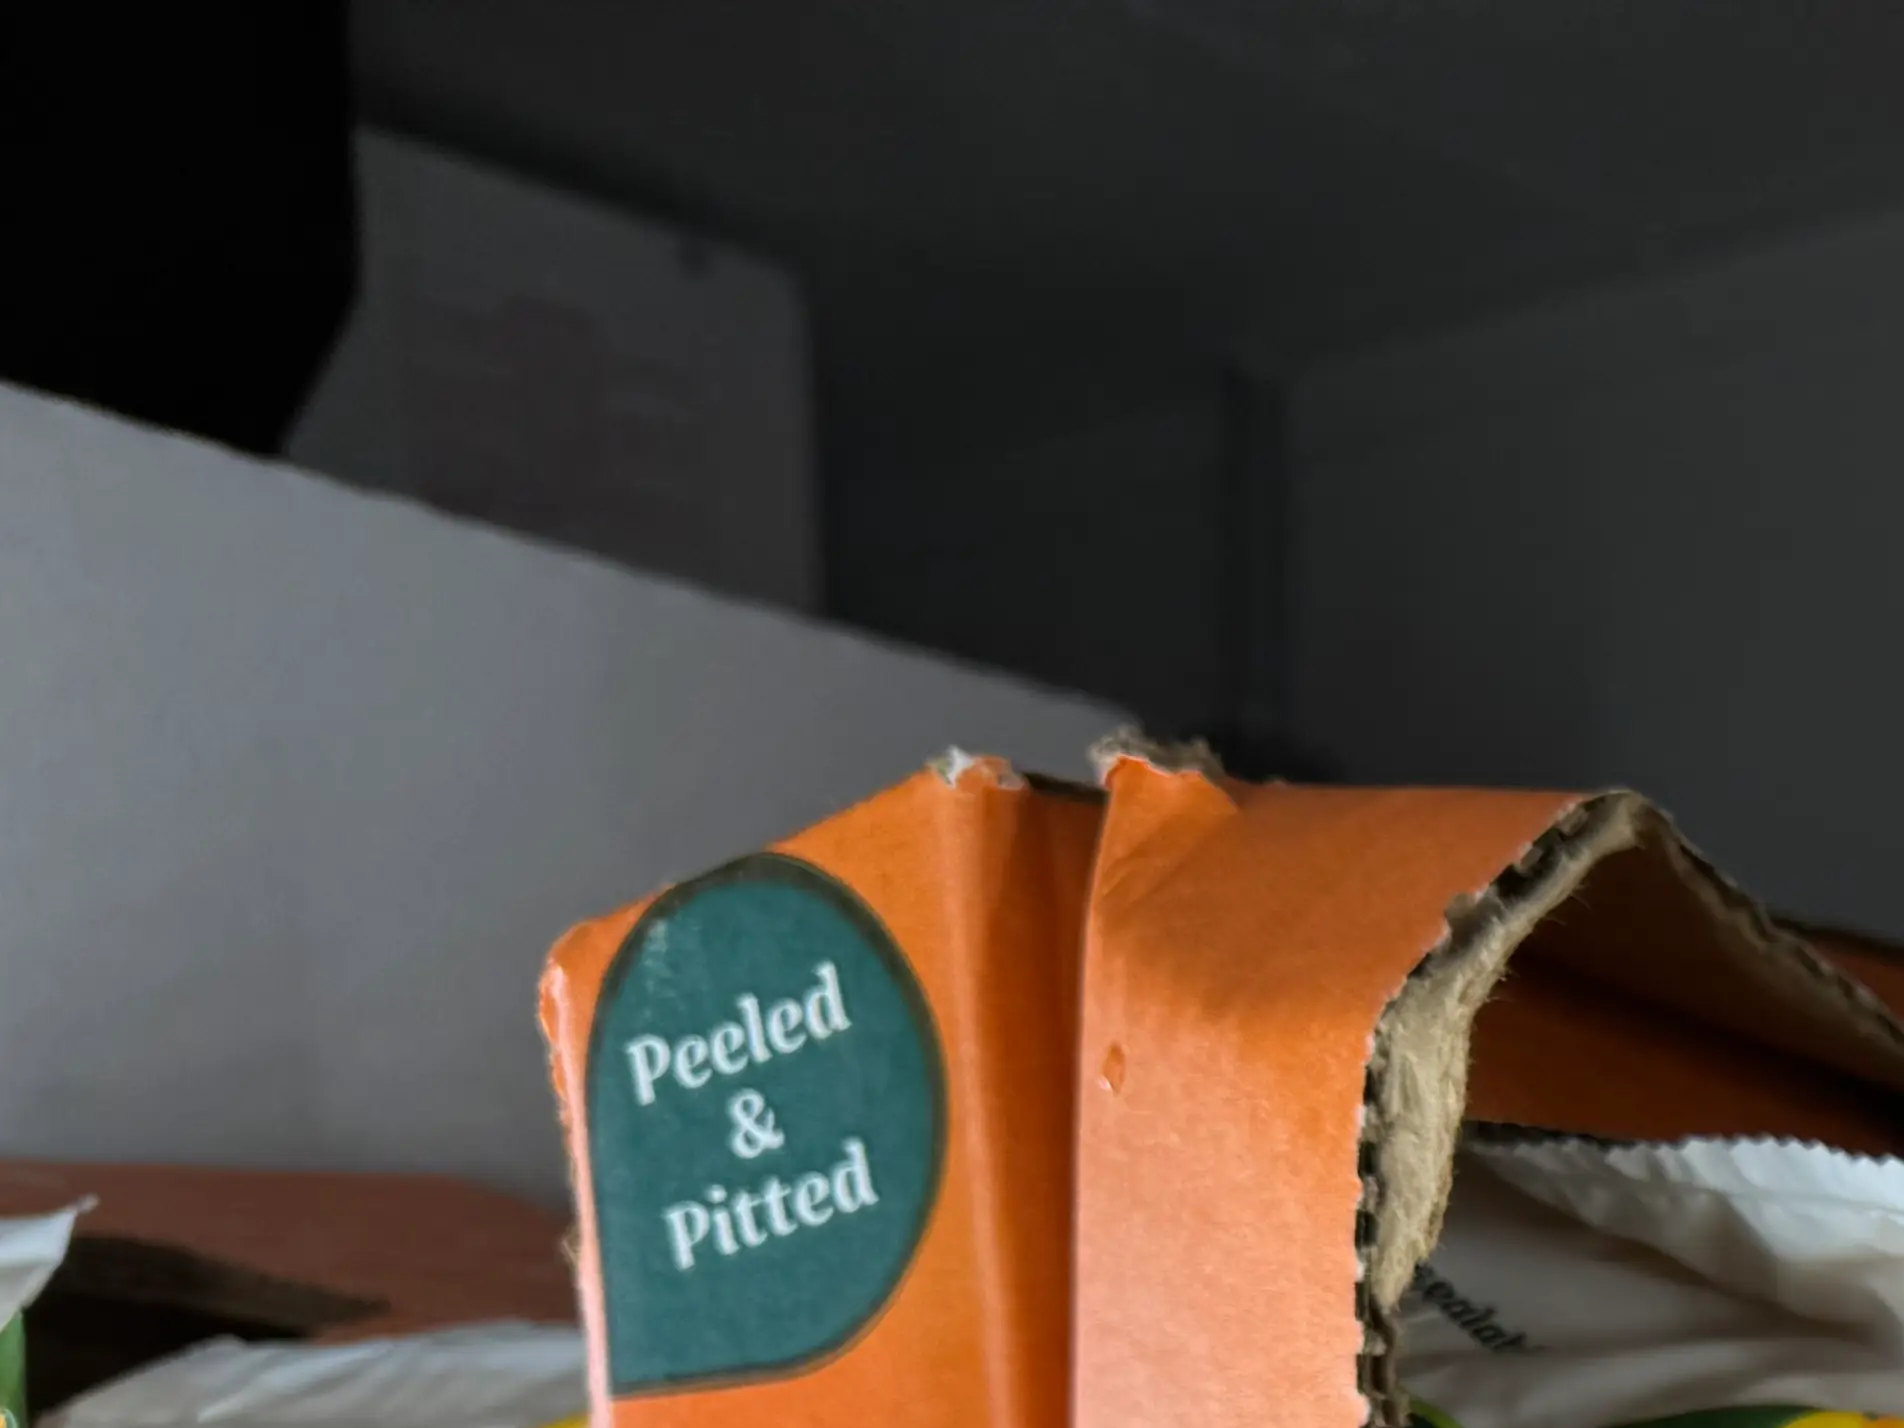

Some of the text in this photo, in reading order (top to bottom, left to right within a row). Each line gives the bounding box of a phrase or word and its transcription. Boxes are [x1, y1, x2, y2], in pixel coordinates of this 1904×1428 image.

[625, 961, 851, 1105] Peeled
[727, 1090, 783, 1158] &
[666, 1139, 878, 1270] Pitted
